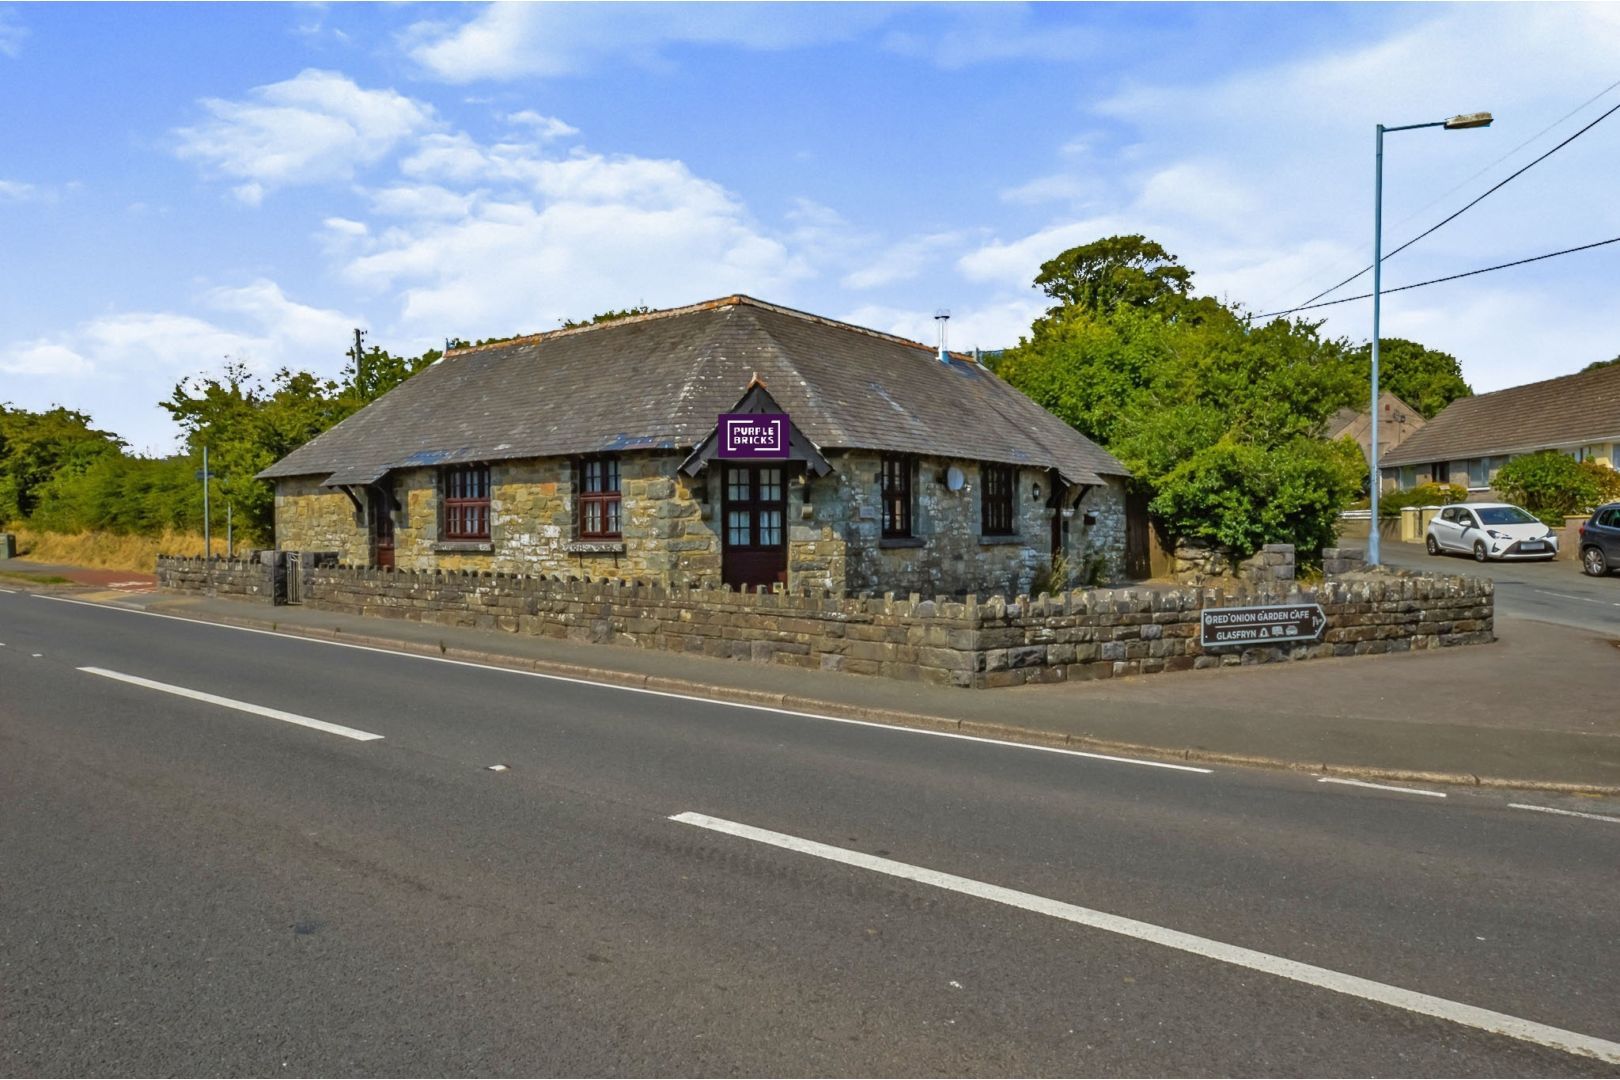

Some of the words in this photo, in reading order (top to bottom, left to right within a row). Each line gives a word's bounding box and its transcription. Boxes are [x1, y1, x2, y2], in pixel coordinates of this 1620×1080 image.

[1213, 615, 1229, 624] RED
[1230, 613, 1256, 622] ONION
[1257, 612, 1288, 621] GARDEN
[1216, 630, 1257, 640] GLASFRYN
